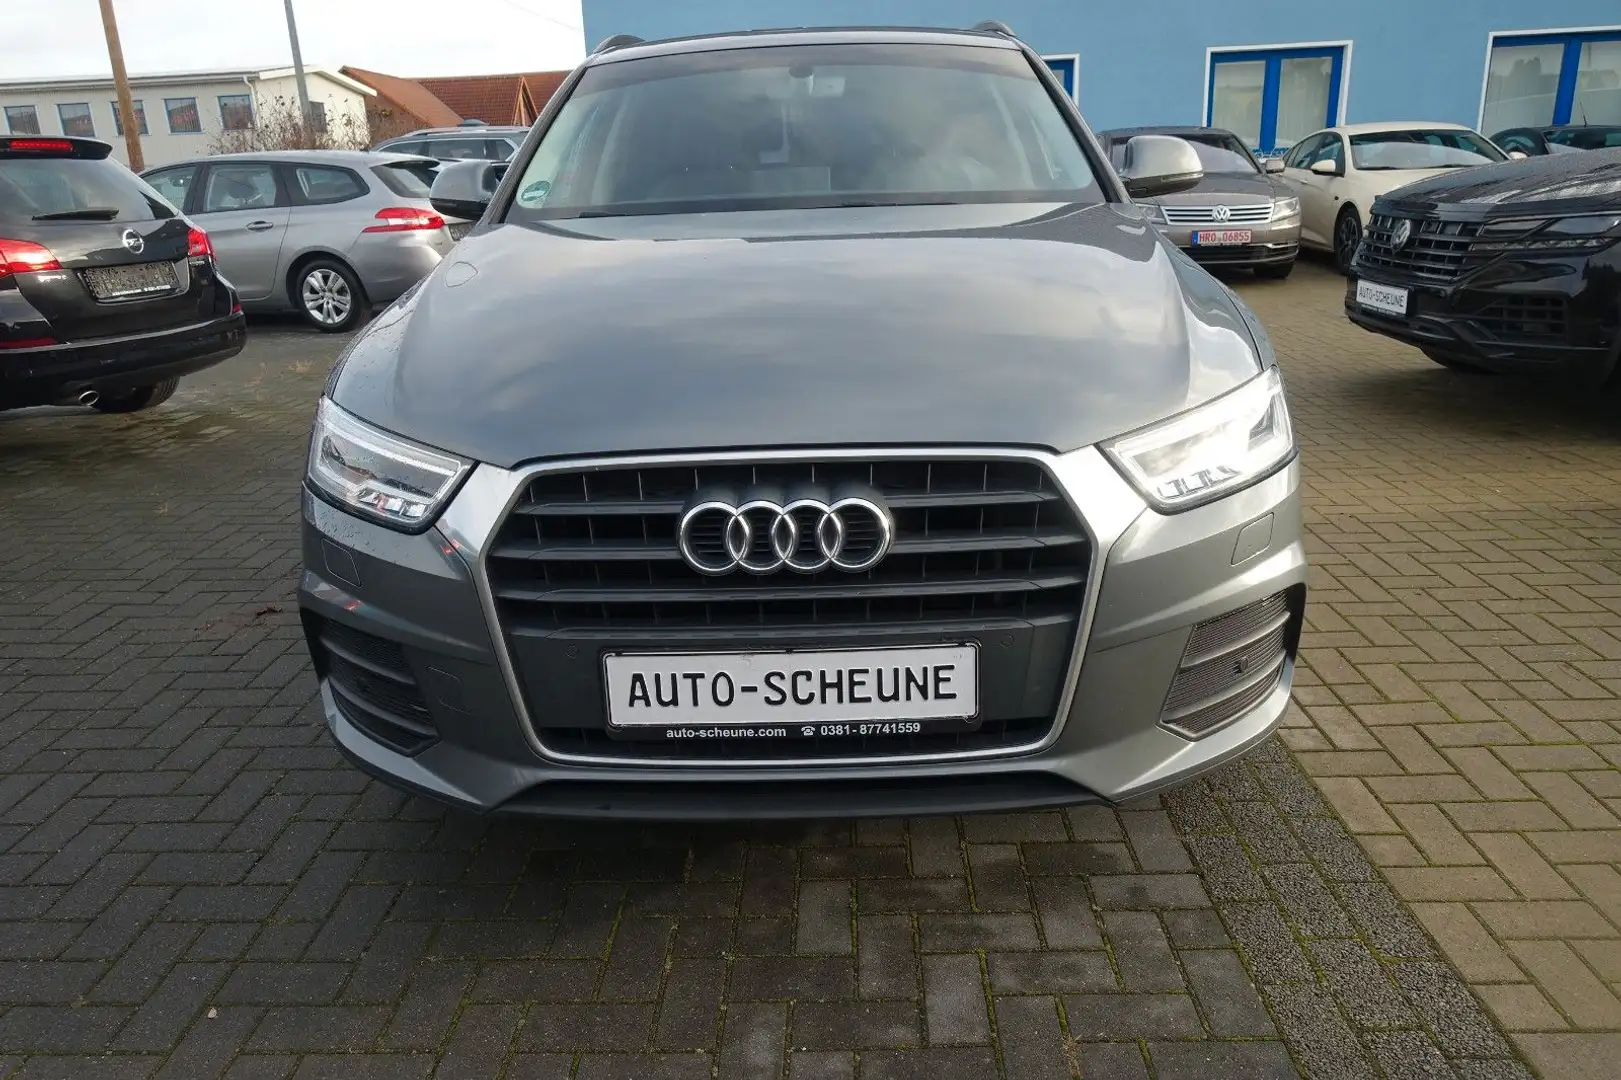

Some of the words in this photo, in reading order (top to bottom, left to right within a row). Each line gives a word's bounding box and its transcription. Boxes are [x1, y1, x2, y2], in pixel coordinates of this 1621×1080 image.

[1199, 232, 1217, 242] HRO
[1359, 285, 1405, 308] AUTO-SCHEUNE
[628, 664, 958, 708] AUTO-SCHEUNE
[666, 727, 787, 738] auto-scheune.com
